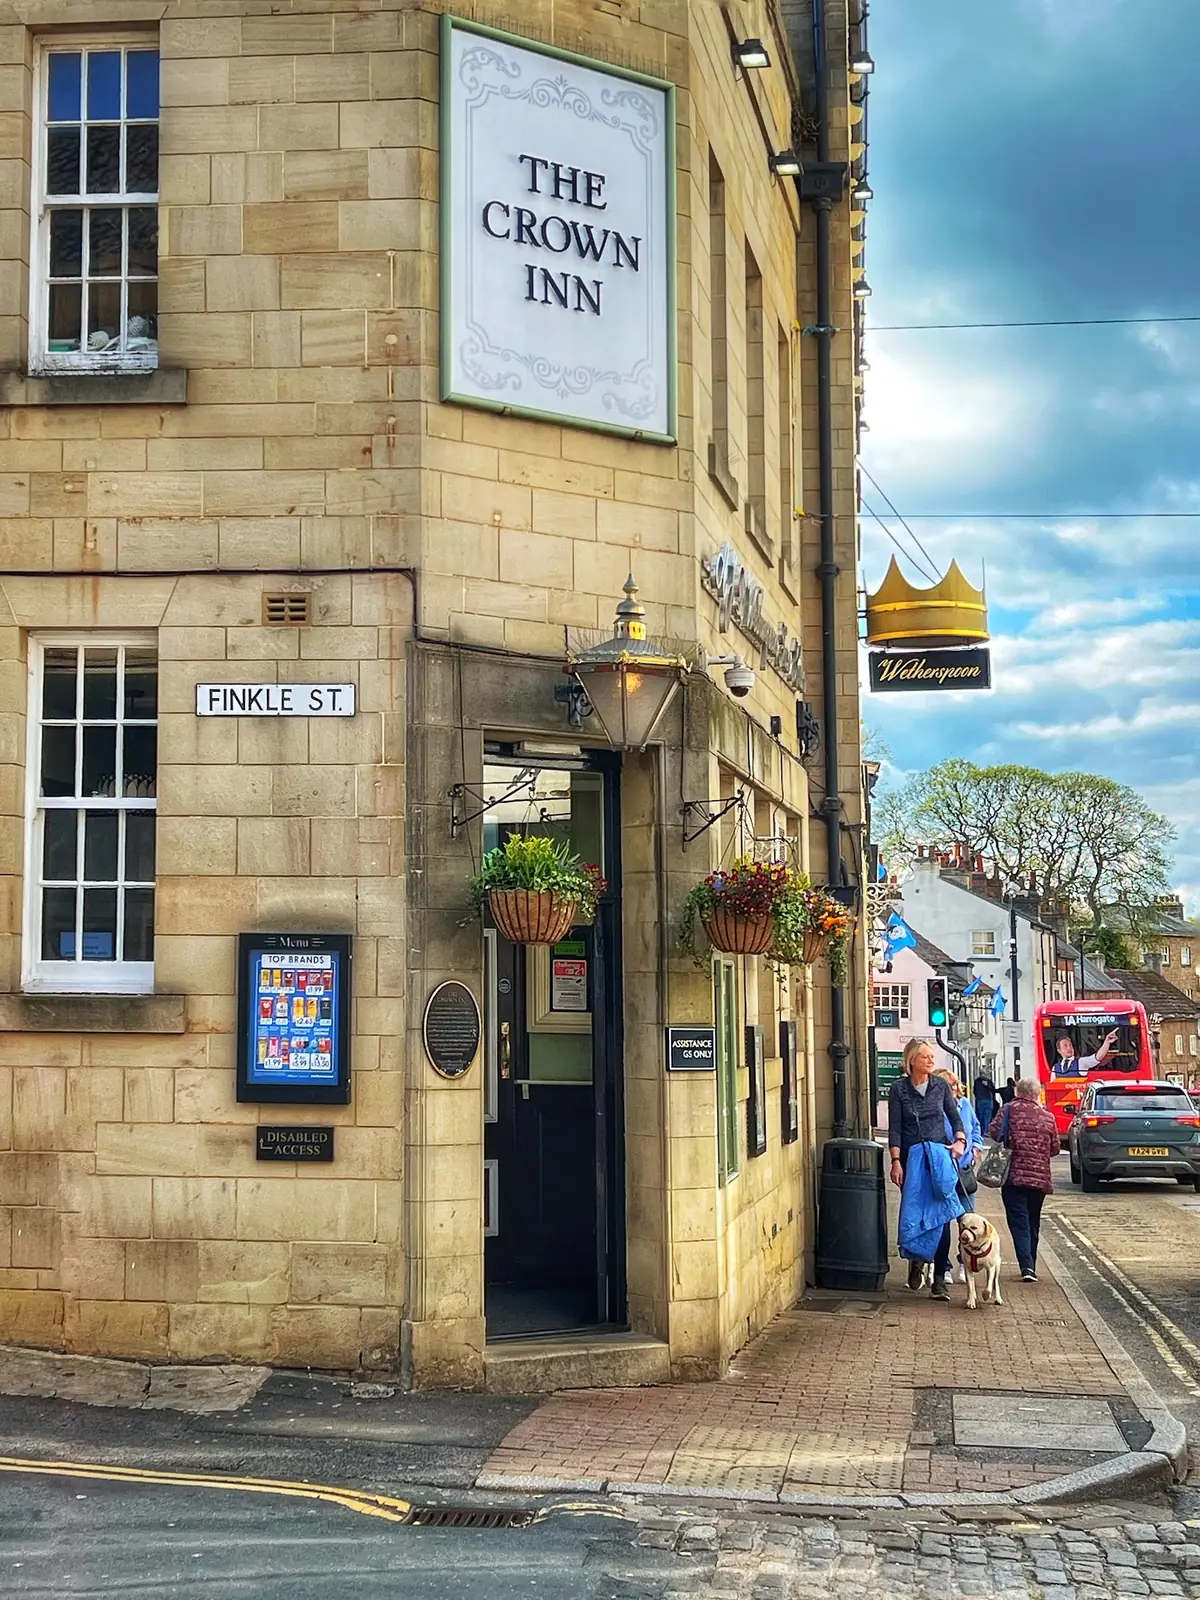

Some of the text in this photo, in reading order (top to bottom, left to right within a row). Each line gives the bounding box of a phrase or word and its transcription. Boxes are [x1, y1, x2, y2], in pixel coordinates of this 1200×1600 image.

[518, 154, 608, 211] THE
[482, 200, 642, 273] CROWN
[524, 263, 604, 317] INN
[877, 658, 982, 685] Wetherspoon
[208, 688, 343, 712] FINKLE ST.
[280, 936, 309, 947] Menu
[268, 955, 325, 964] TOP BRANDS
[1064, 1015, 1116, 1026] 1A Harrogate
[672, 1039, 713, 1048] ASSISTANCE
[693, 1050, 713, 1059] ONLY
[267, 1131, 329, 1143] DISABLED
[273, 1144, 321, 1156] ACCESS
